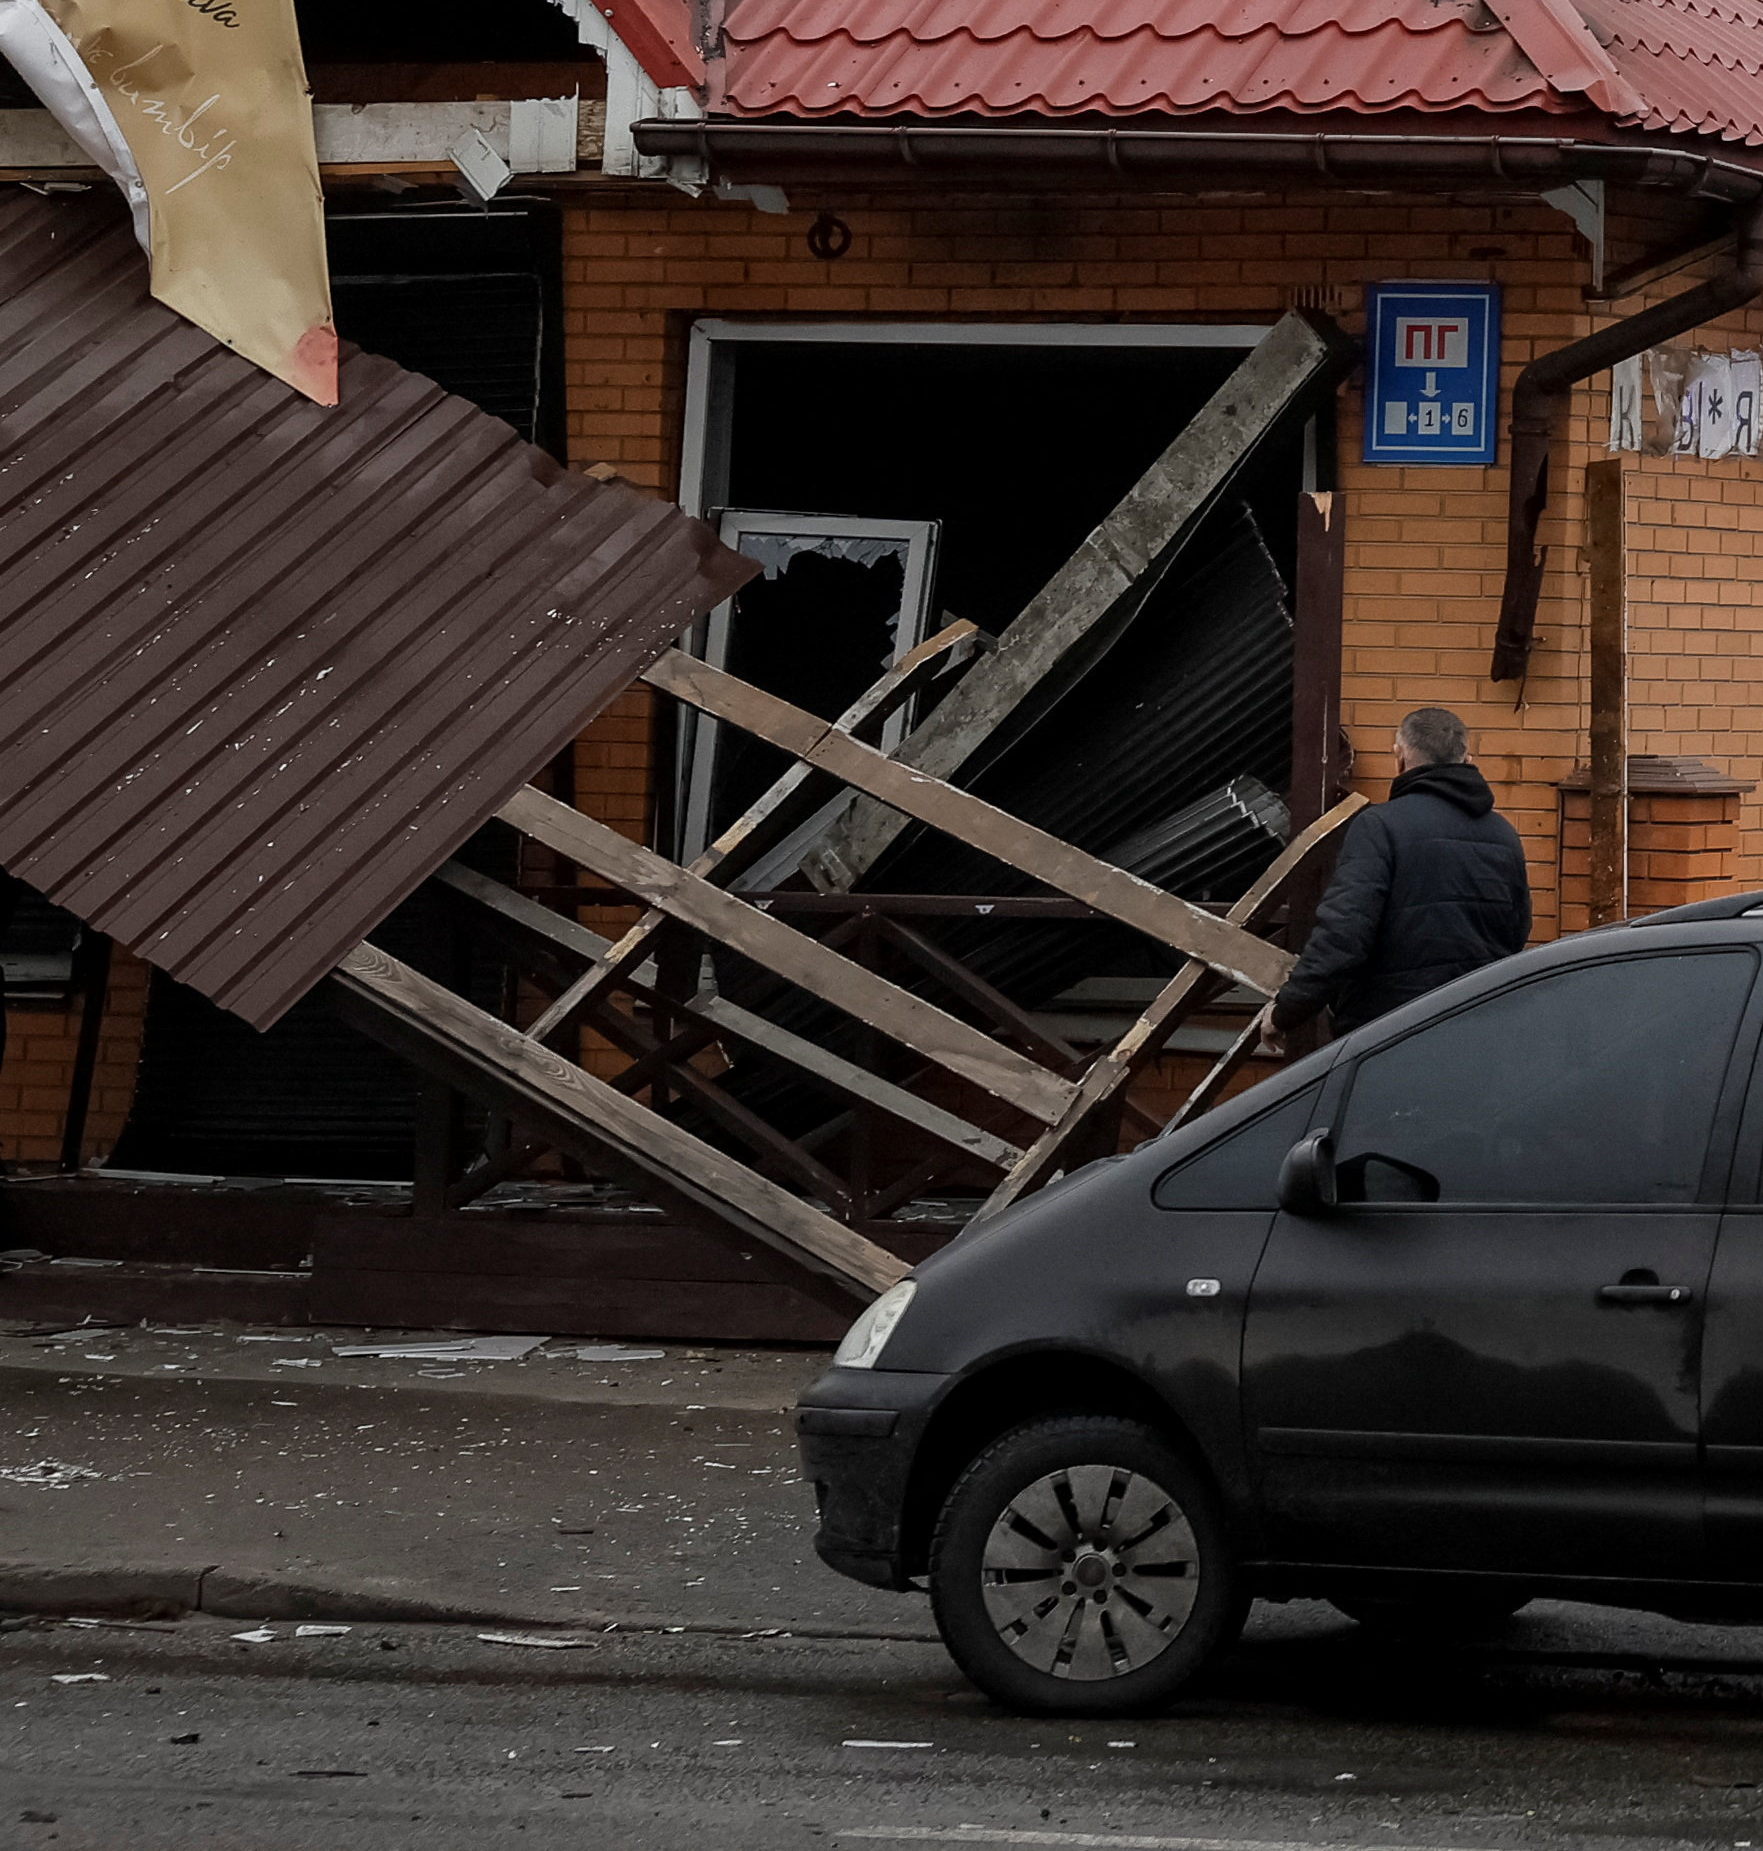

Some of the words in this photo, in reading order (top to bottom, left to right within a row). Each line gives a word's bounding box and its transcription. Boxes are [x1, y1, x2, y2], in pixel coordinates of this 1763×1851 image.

[1405, 324, 1459, 360] ПГ
[1424, 409, 1435, 427] 1
[1457, 408, 1469, 427] 6
